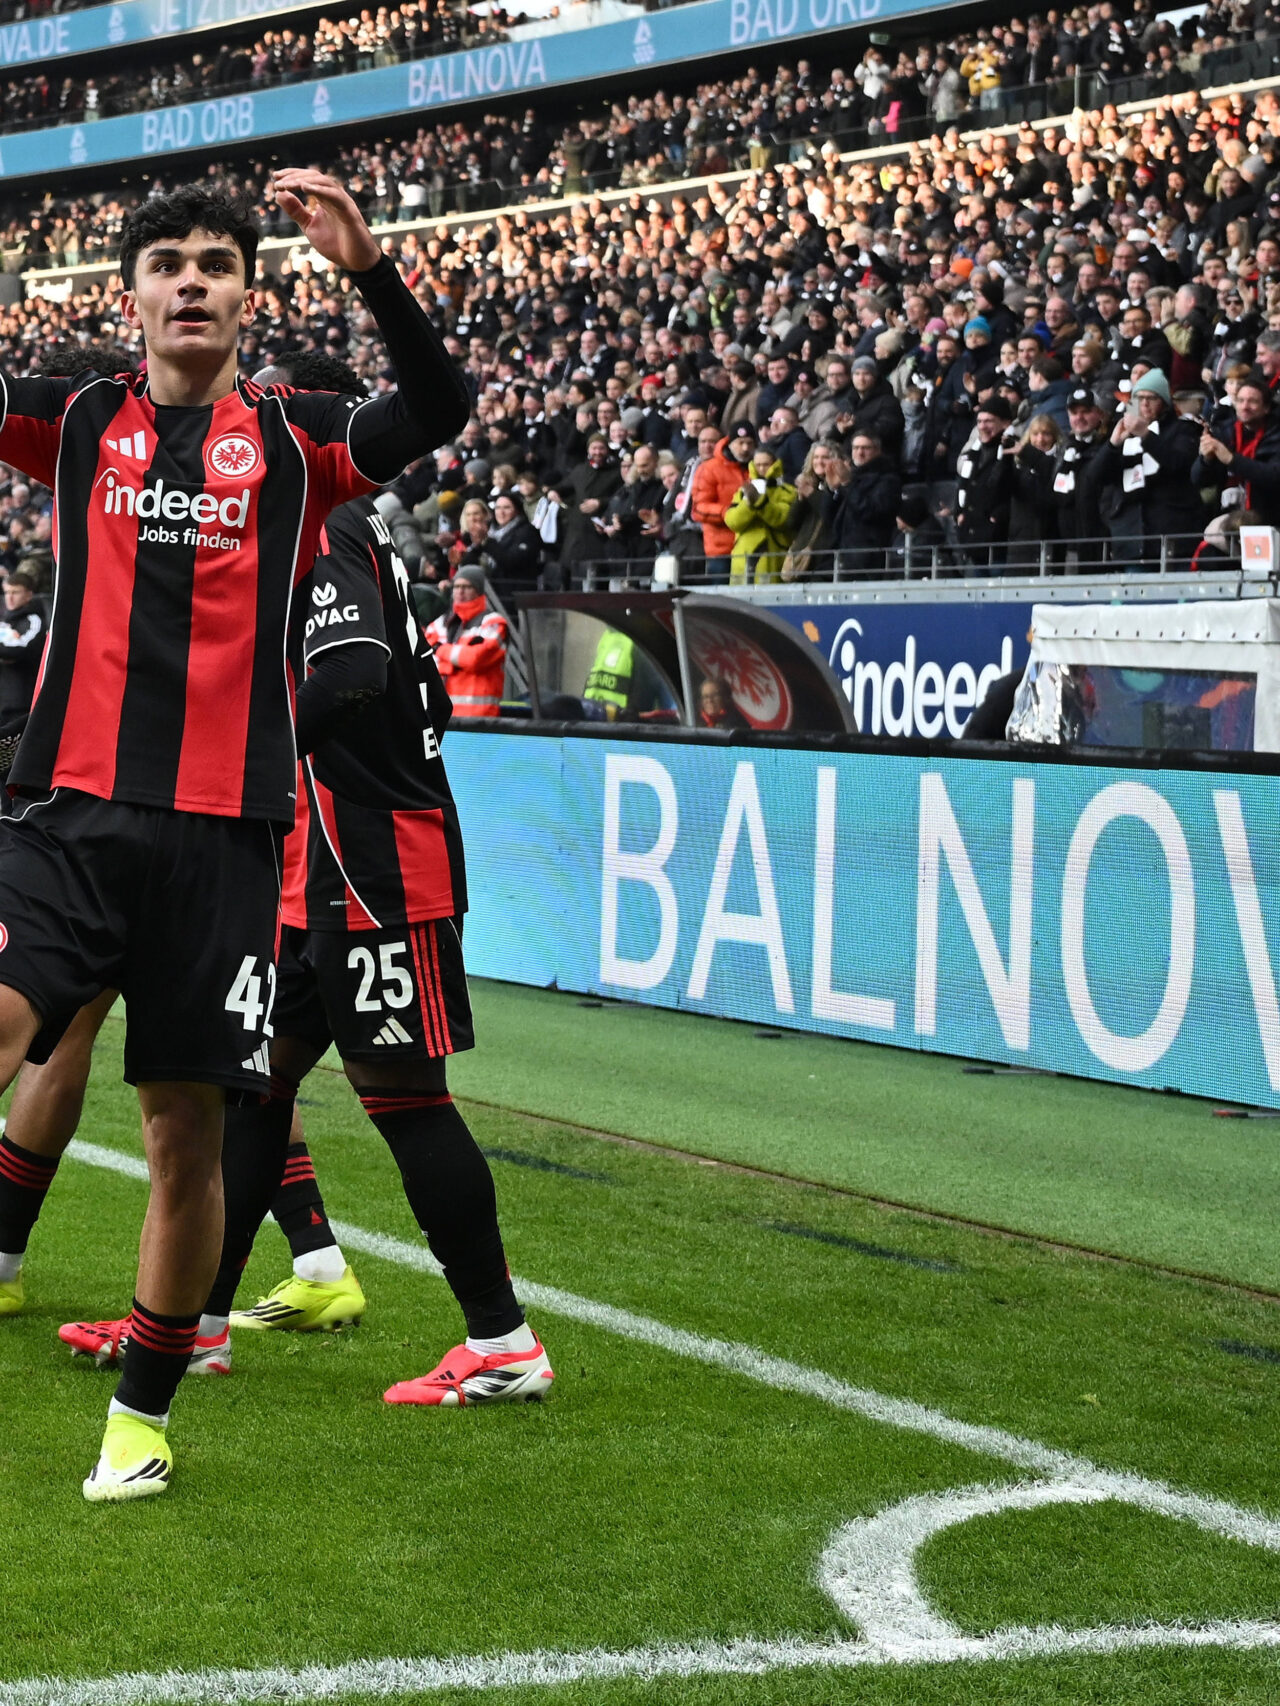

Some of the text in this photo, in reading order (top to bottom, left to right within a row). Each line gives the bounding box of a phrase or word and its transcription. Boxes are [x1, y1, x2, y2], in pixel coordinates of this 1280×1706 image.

[408, 40, 547, 107] BALNOVA
[142, 95, 255, 154] BAD ORB
[96, 468, 251, 529] indeed
[138, 525, 241, 551] Jobs finden
[224, 955, 277, 1038] 42
[347, 941, 414, 1013] 25
